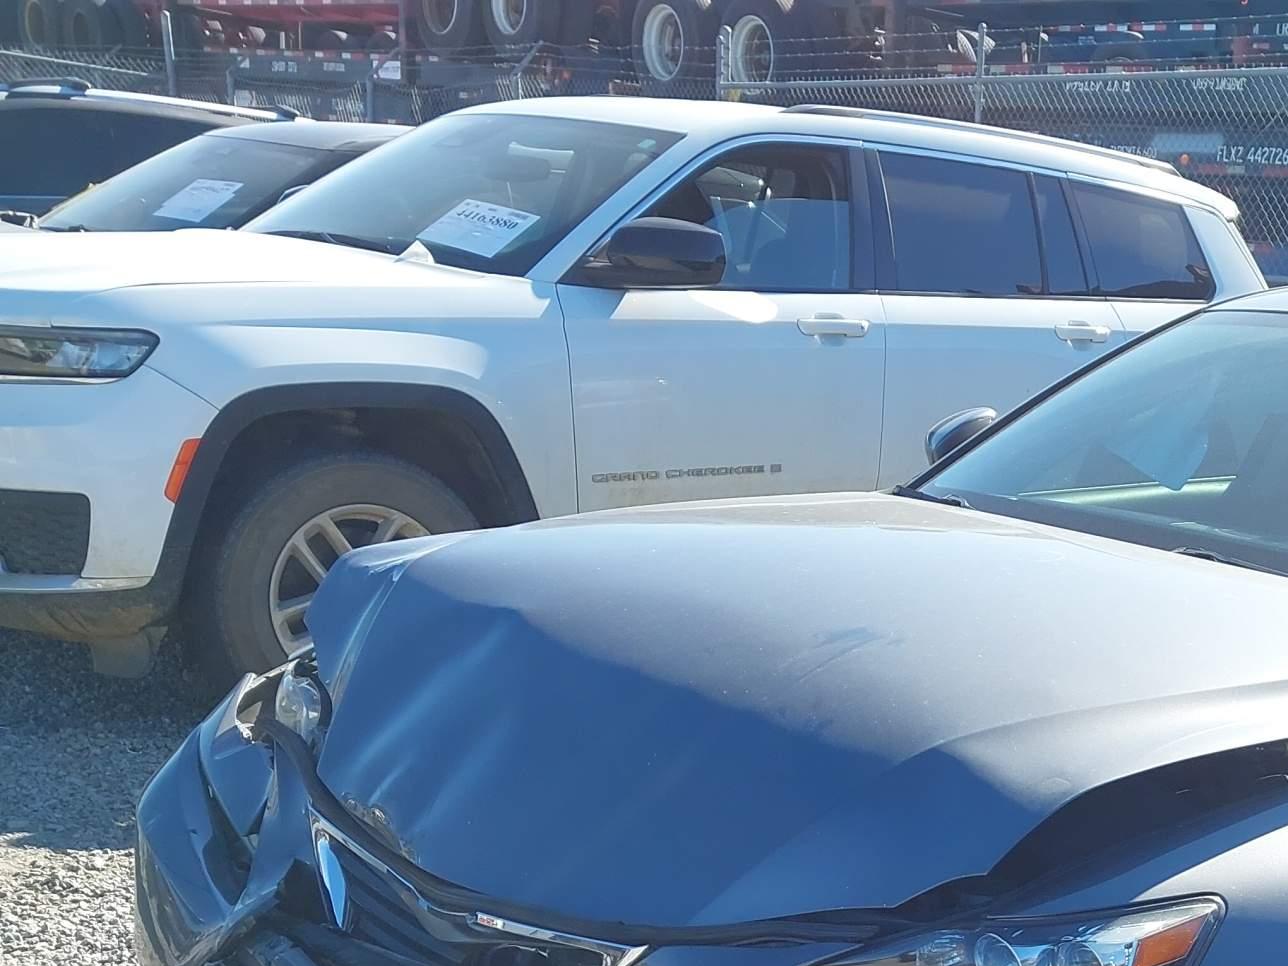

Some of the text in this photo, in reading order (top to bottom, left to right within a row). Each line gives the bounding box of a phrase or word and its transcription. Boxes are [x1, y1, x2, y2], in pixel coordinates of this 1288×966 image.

[1247, 146, 1288, 165] 442726
[591, 470, 660, 483] GRAND
[665, 464, 765, 478] CHEROKEE
